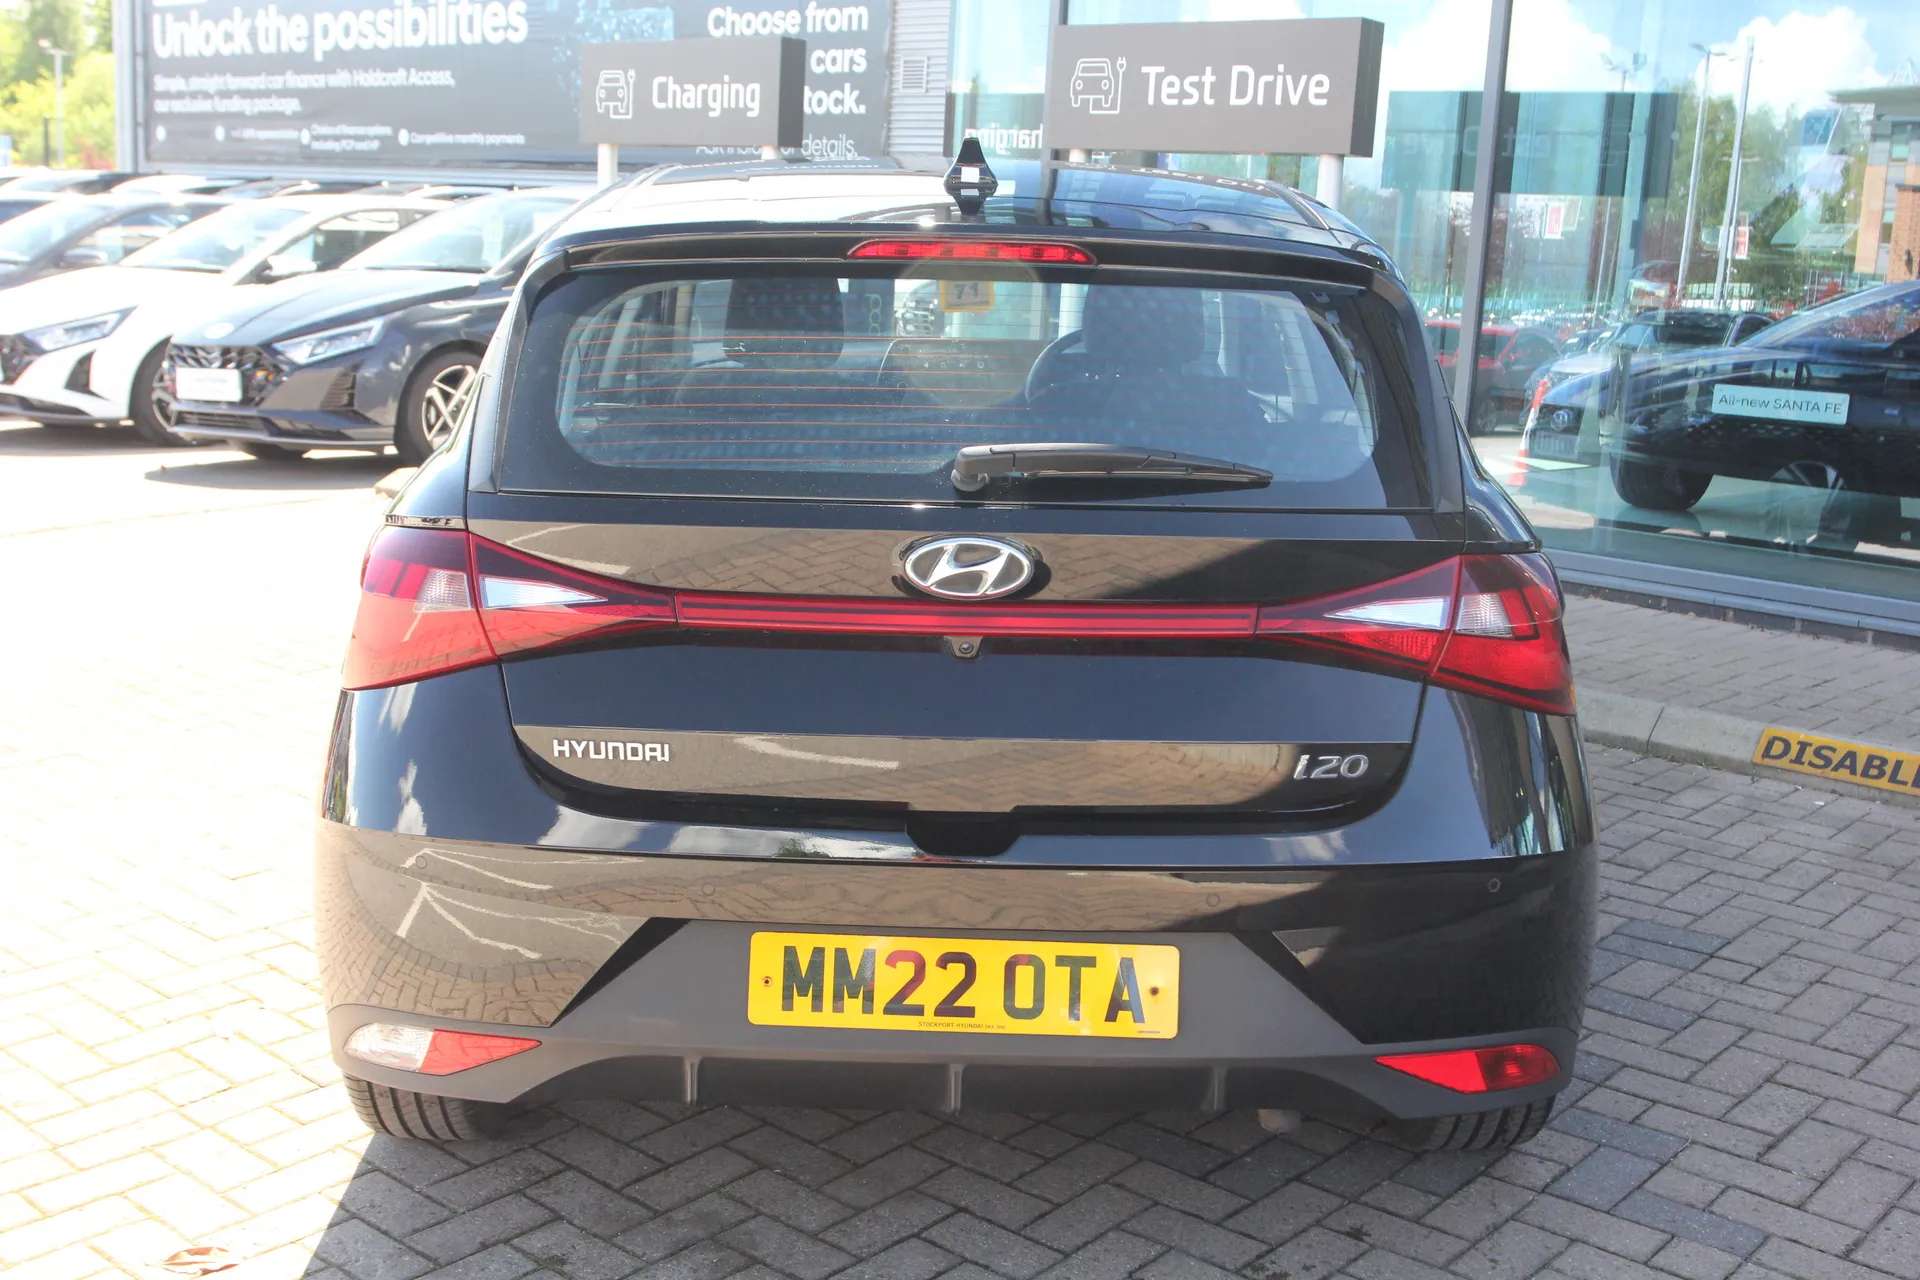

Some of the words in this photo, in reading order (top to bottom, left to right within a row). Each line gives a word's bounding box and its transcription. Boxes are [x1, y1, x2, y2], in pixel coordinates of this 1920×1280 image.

[152, 7, 254, 58] Unlock
[255, 4, 308, 54] the
[313, 0, 528, 62] possibilities
[707, 5, 801, 37] Choose
[805, 1, 868, 33] from
[810, 47, 867, 74] cars
[326, 67, 352, 88] with
[407, 67, 456, 88] Access,
[1140, 65, 1216, 106] Test
[1230, 63, 1330, 106] Drive
[652, 74, 761, 117] Charging
[803, 83, 866, 114] tock.
[801, 133, 858, 157] details.
[1718, 394, 1770, 409] All-new
[1773, 398, 1821, 413] SANTA
[1824, 402, 1843, 415] FE
[552, 738, 671, 763] HYUNDAI
[1293, 753, 1370, 781] i20
[781, 945, 977, 1019] MM22
[1003, 953, 1146, 1024] OTA
